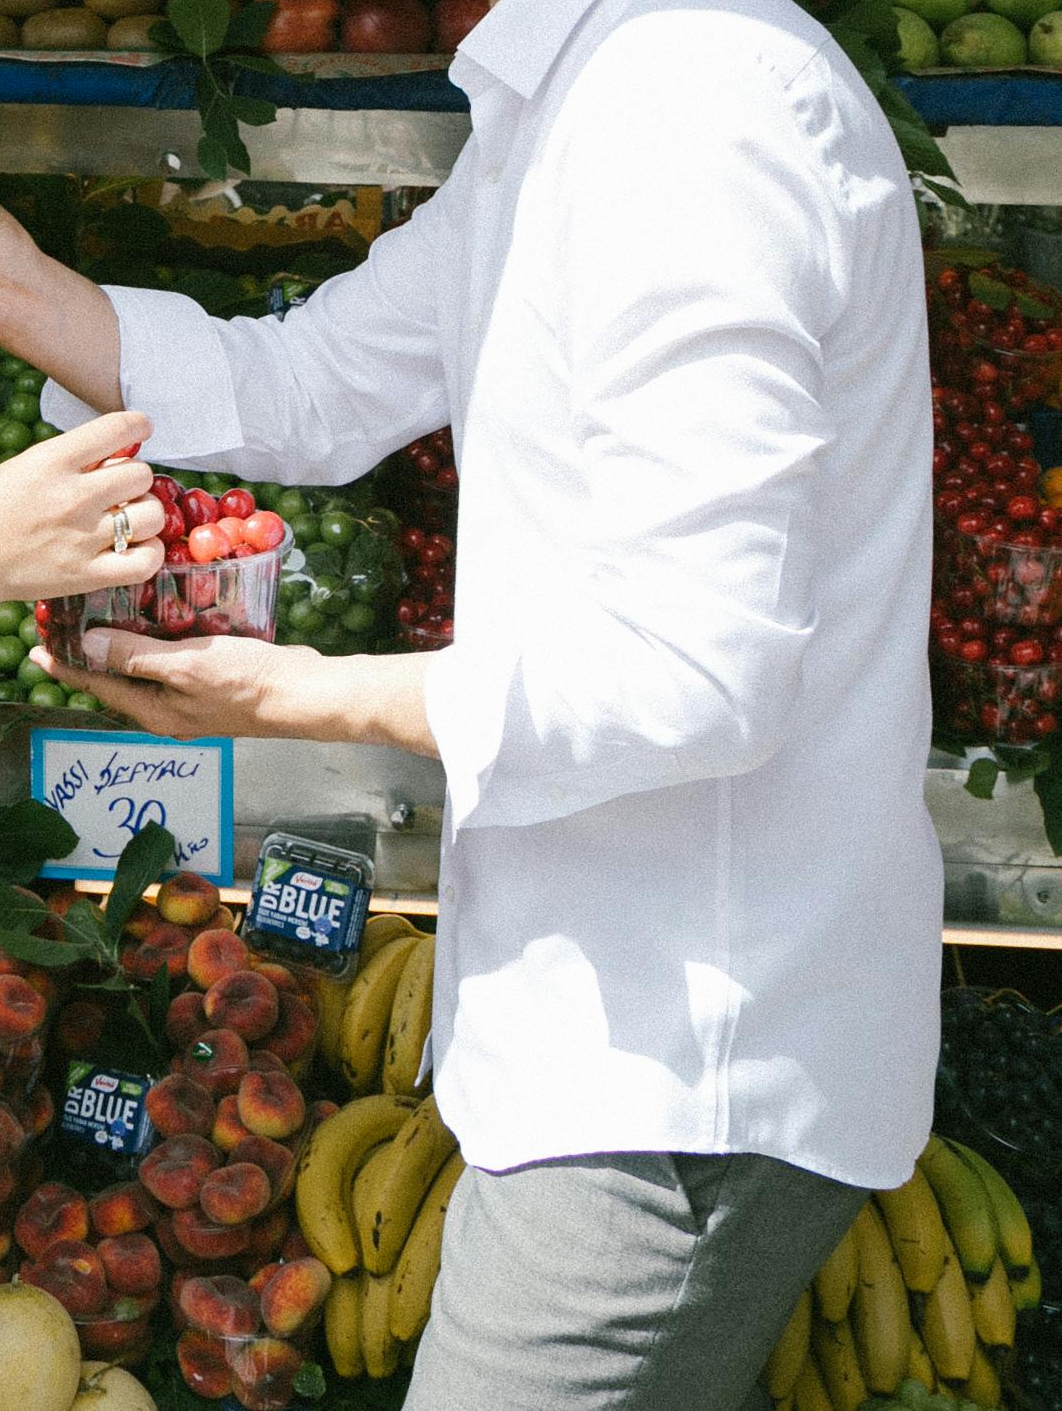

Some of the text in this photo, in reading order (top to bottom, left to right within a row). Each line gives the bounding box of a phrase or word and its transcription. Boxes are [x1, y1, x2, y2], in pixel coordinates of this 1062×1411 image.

[259, 881, 282, 910] DR
[279, 884, 345, 929] BLUE
[64, 1085, 84, 1115] DR
[79, 1089, 138, 1130] BLUE
